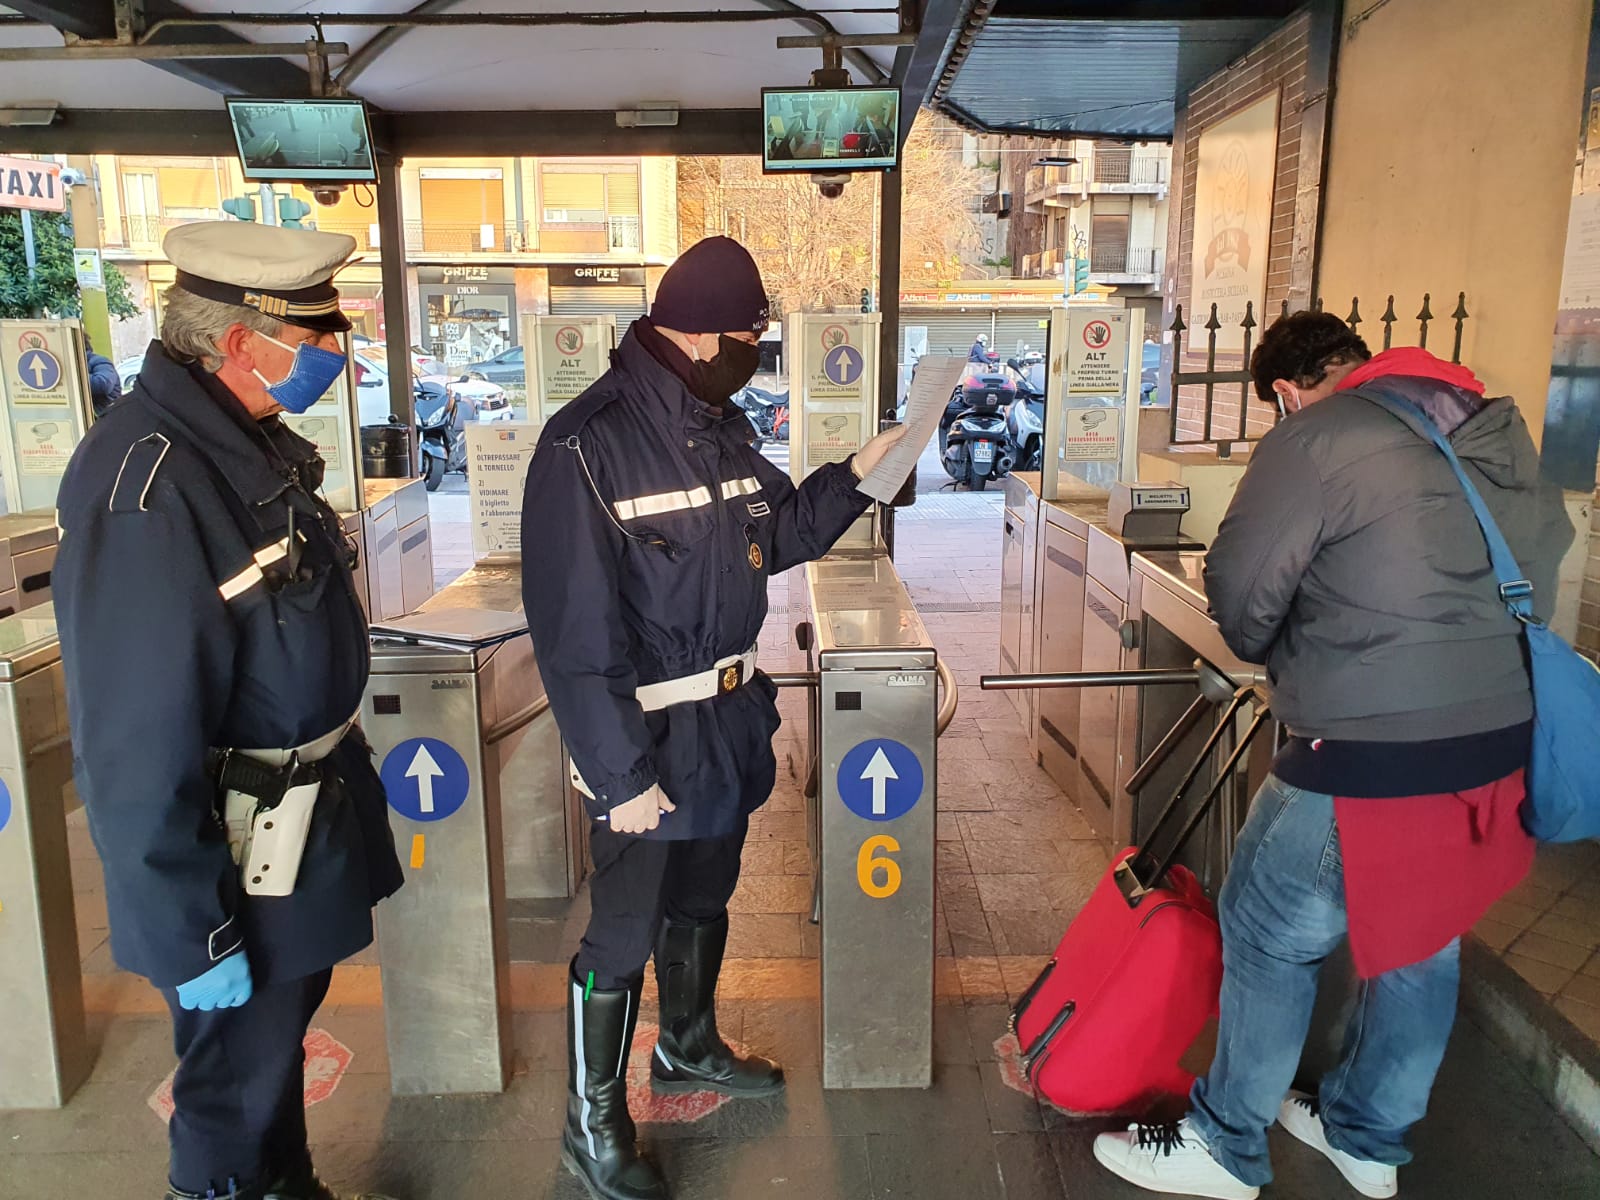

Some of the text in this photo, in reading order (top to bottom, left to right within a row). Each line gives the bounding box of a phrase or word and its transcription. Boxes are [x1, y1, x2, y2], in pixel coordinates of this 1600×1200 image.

[443, 266, 488, 276] GRIFFE
[575, 268, 620, 277] GRIFFE
[457, 286, 479, 294] DIOR
[1086, 352, 1107, 361] ALT
[560, 359, 582, 368] ALT
[484, 499, 510, 508] biglietto
[485, 509, 521, 517] l'abbonamen
[857, 834, 902, 899] 6
